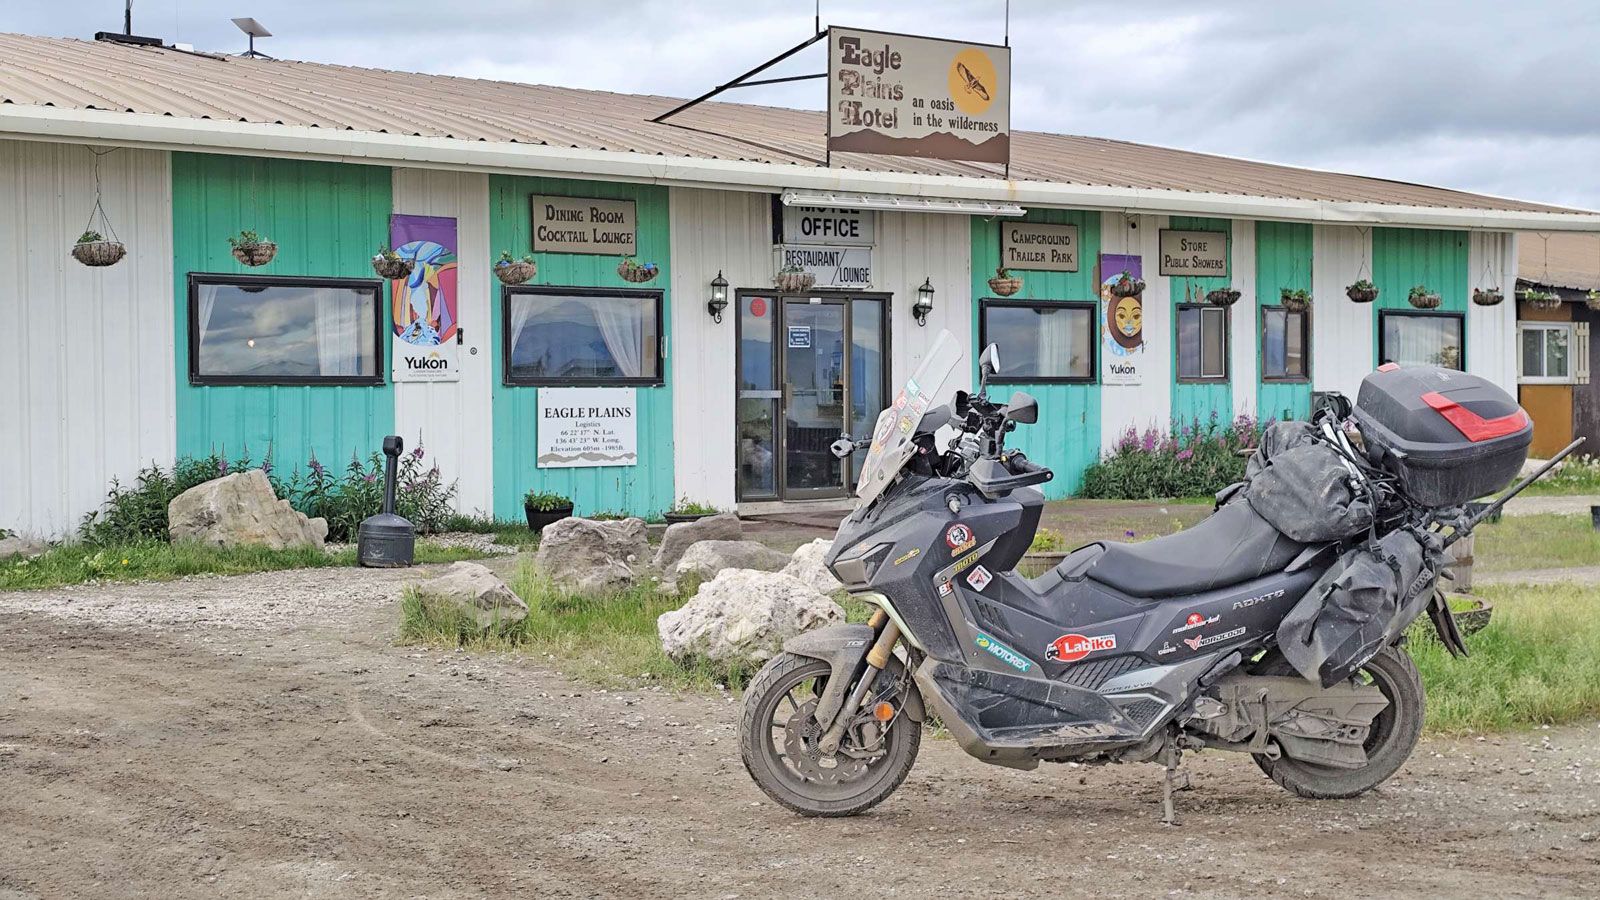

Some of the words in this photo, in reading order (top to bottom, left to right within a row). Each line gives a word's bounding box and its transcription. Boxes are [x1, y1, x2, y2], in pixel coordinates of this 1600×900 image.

[838, 36, 901, 74] Eagle
[838, 69, 903, 101] Plains
[912, 97, 924, 108] an
[930, 98, 954, 111] oasis
[838, 100, 898, 129] Hotel
[913, 112, 922, 125] in
[927, 114, 942, 127] the
[949, 116, 998, 132] wilderness
[801, 217, 859, 237] OFFICE
[785, 250, 840, 266] RESTAURANT
[839, 267, 869, 283] LOUNGE
[404, 356, 447, 369] Yukon
[1110, 364, 1135, 374] Yukon
[544, 407, 585, 418] EAGLE
[588, 407, 631, 418] PLAINS
[1065, 639, 1114, 654] Labiko
[987, 642, 1030, 671] MOTOREX
